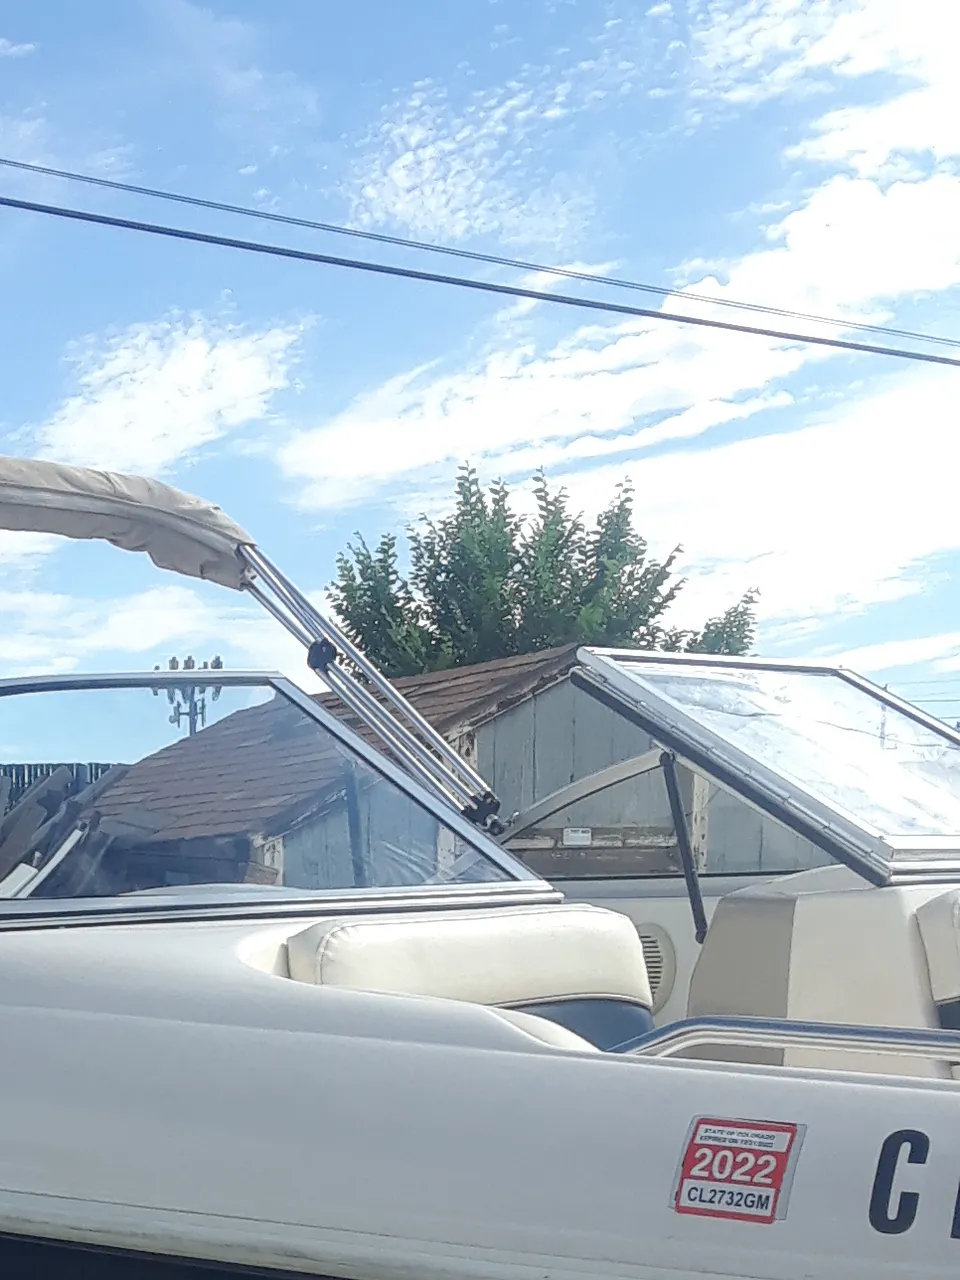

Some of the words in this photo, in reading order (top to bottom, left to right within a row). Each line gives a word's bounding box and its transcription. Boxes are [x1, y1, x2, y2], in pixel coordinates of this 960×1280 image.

[690, 1148, 777, 1185] 2022
[869, 1129, 960, 1239] C
[687, 1187, 771, 1210] CL2732GM
